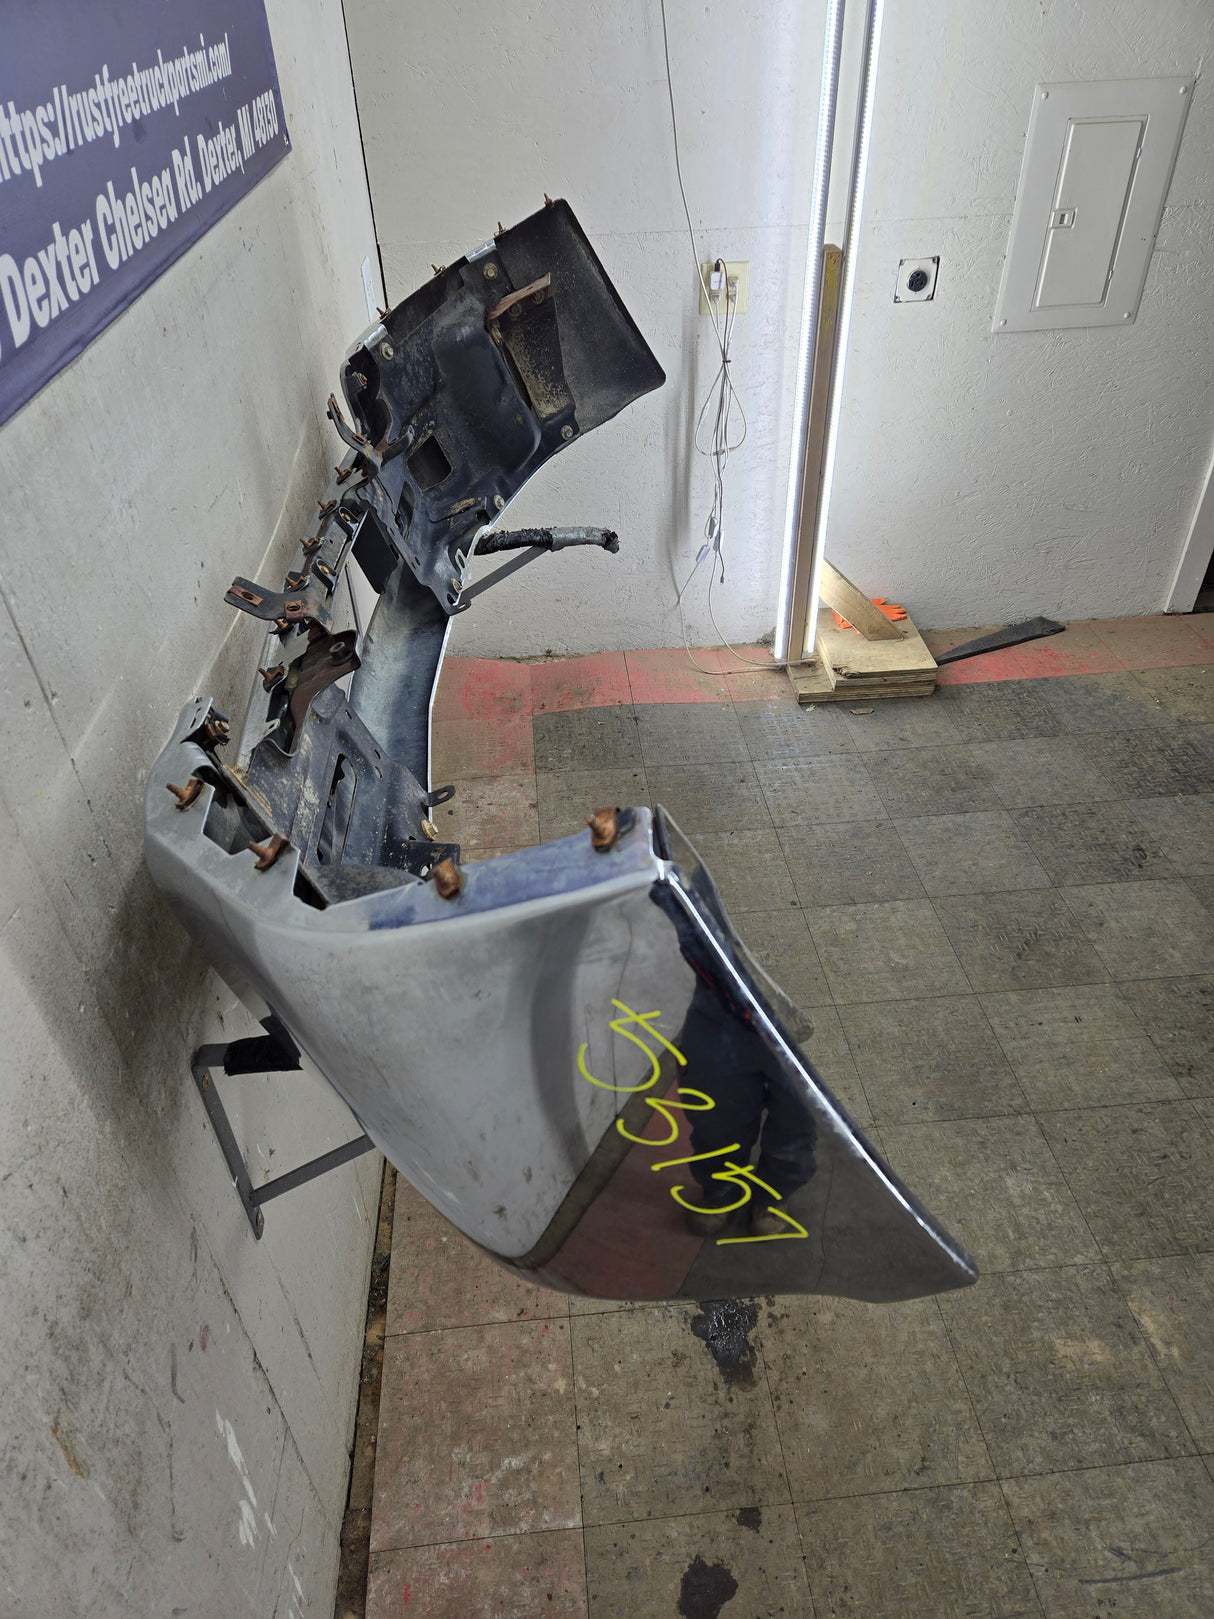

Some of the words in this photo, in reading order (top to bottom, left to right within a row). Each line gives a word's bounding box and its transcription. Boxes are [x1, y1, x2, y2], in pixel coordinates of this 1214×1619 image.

[0, 218, 100, 348] Dexter
[96, 166, 178, 270] Chelsea
[171, 135, 203, 213] Rd.
[196, 121, 245, 193] Dexter,
[237, 104, 255, 160] MI
[252, 89, 279, 148] 48130
[577, 998, 809, 1245] 53157
